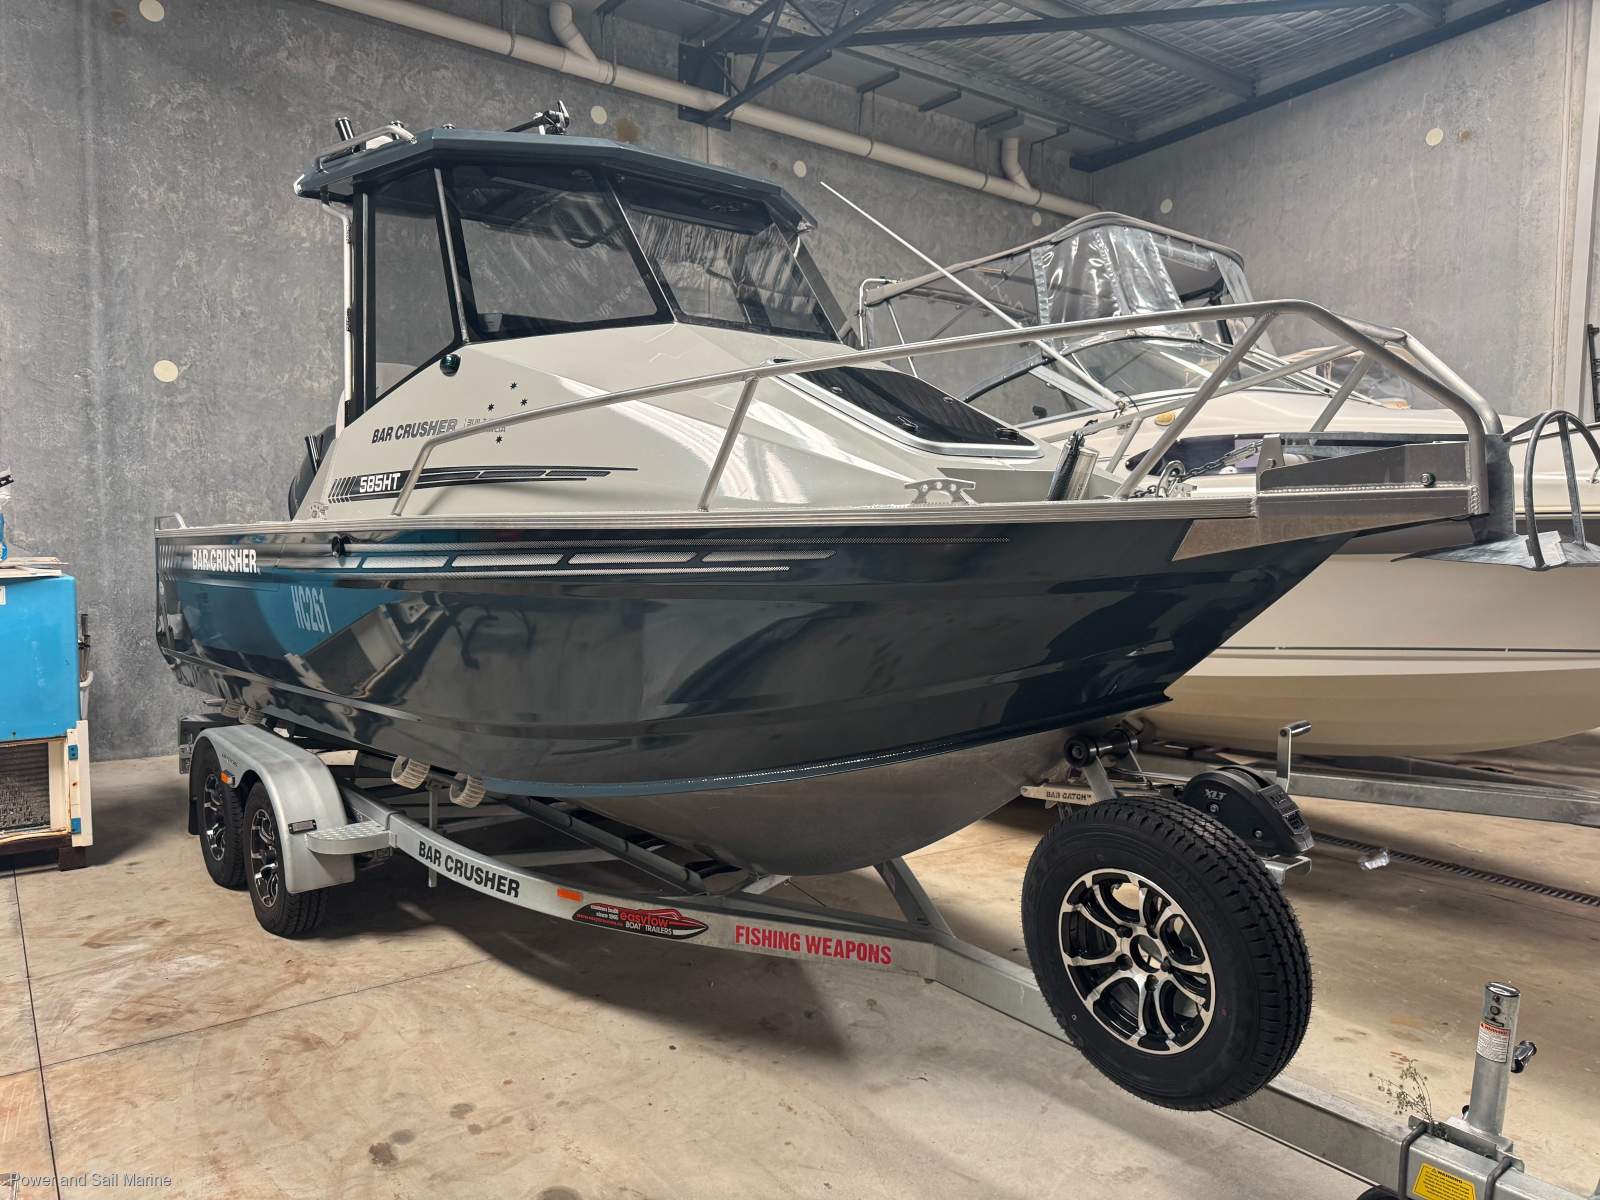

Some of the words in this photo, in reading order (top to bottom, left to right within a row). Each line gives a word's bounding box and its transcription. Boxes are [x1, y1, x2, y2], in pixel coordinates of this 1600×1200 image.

[371, 426, 394, 444] BAR
[394, 419, 458, 440] CRUSHER
[359, 472, 401, 493] 585HT
[192, 549, 209, 571] BAR
[210, 549, 257, 574] CRUSHER
[290, 585, 332, 634] HC261
[418, 840, 442, 867] BAR
[444, 855, 521, 898] CRUSHER
[625, 921, 642, 930] BOAT
[645, 924, 673, 936] TRAILERS
[735, 925, 801, 952] FISHING
[805, 935, 893, 965] WEAPONS
